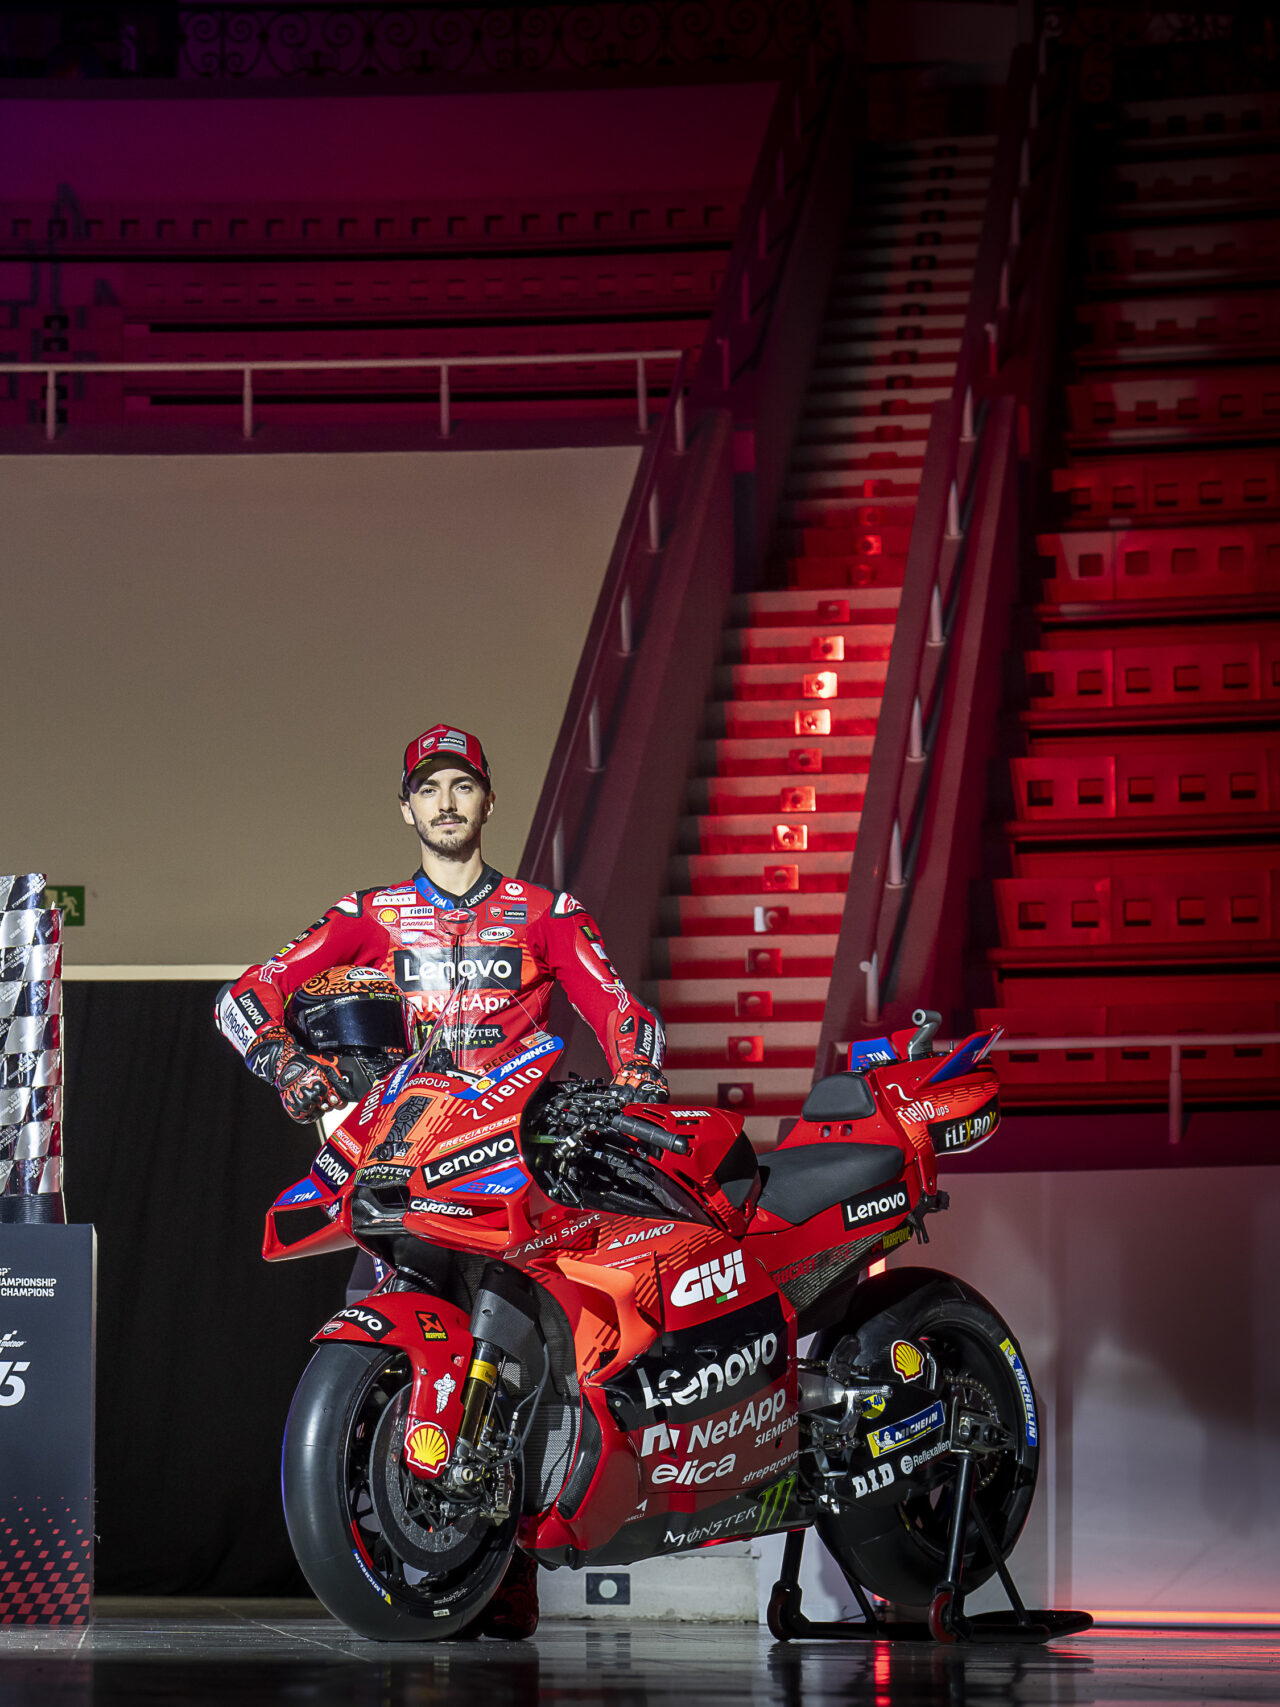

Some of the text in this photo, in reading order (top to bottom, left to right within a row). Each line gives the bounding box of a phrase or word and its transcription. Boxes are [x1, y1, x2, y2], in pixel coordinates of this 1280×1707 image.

[409, 907, 433, 915] riello
[431, 893, 448, 909] TIM
[465, 884, 492, 907] Lenovo
[350, 969, 386, 978] SUOM
[404, 958, 512, 982] Lenovo
[239, 993, 263, 1025] Lenovo
[639, 1024, 653, 1056] Lenovo
[500, 1040, 555, 1077] ADVANCE
[867, 1051, 889, 1063] TIM
[481, 1067, 544, 1111] riello
[358, 1084, 385, 1126] riello
[670, 1110, 711, 1118] DUCATI
[897, 1101, 949, 1125] riello ups
[439, 1116, 517, 1150] FRECCIAROSSA
[315, 1146, 349, 1185] Lenovo
[363, 1166, 410, 1177] MONSTER
[424, 1139, 515, 1183] Lenovo
[293, 1191, 314, 1203] TIM
[484, 1183, 514, 1194] TIM
[410, 1200, 473, 1216] CARRERA
[847, 1192, 906, 1223] Lenovo
[524, 1213, 600, 1253] Audi Sport
[624, 1223, 675, 1246] DAIKO
[1, 1288, 54, 1297] CHAMPIONS
[670, 1249, 746, 1307] GIVI
[637, 1333, 777, 1409] Lenovo
[1016, 1368, 1035, 1438] MICHELIN
[686, 1388, 786, 1453] NetApp
[755, 1411, 799, 1448] SIEMENS
[895, 1411, 938, 1441] MICHELIN
[651, 1454, 737, 1485] elica
[742, 1450, 799, 1485] streparava
[664, 1505, 758, 1546] MONSTER
[354, 1553, 380, 1592] MICHELIN
